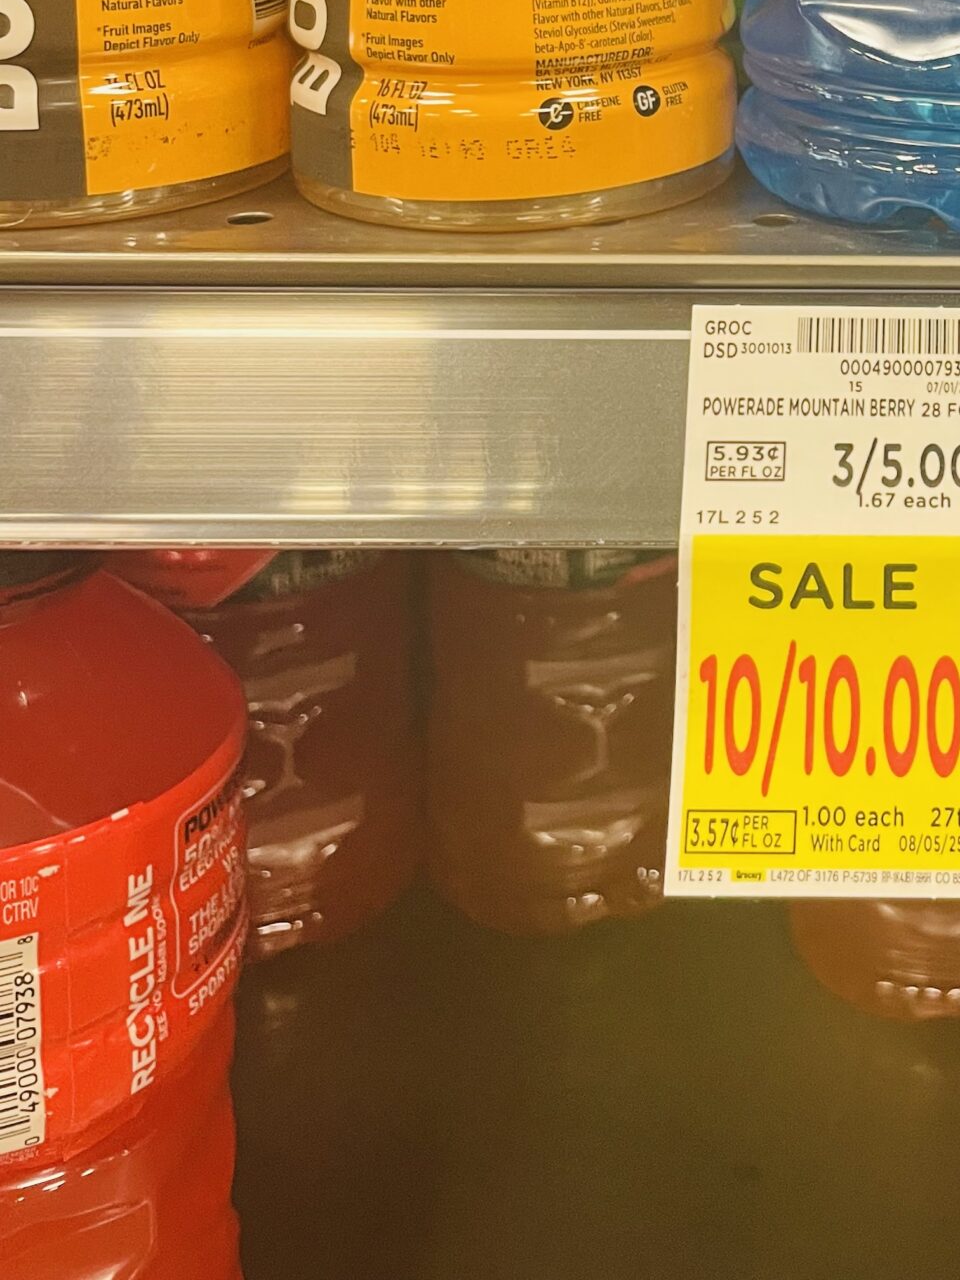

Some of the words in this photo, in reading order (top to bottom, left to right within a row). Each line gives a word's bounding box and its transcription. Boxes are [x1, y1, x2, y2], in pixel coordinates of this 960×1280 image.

[111, 94, 170, 126] (473mL)
[637, 90, 656, 111] GF
[705, 321, 752, 335] GROC
[704, 342, 737, 358] DSD
[741, 342, 792, 354] 3001013
[703, 397, 784, 416] POWERADE
[789, 398, 865, 417] MOUNTAIN
[870, 399, 915, 417] BERRY
[921, 402, 941, 417] 28
[713, 446, 779, 462] 5.93¢
[710, 466, 736, 478] PER
[741, 467, 757, 478] FL
[762, 467, 781, 478] OZ
[858, 493, 895, 508] 1.67
[903, 493, 951, 508] each
[748, 562, 917, 609] SALE
[803, 806, 845, 826] 1.00
[855, 806, 904, 827] each
[690, 818, 739, 847] 3.57¢
[744, 816, 768, 830] PER
[742, 833, 757, 847] FL
[763, 833, 781, 847] OZ
[811, 834, 842, 852] With
[848, 834, 880, 852] Card
[797, 870, 812, 882] OF
[815, 870, 838, 882] 3176
[124, 864, 153, 927] ME
[14, 972, 36, 1041] 07938
[126, 927, 156, 1095] RECYCLE
[17, 1047, 39, 1112] 49000
